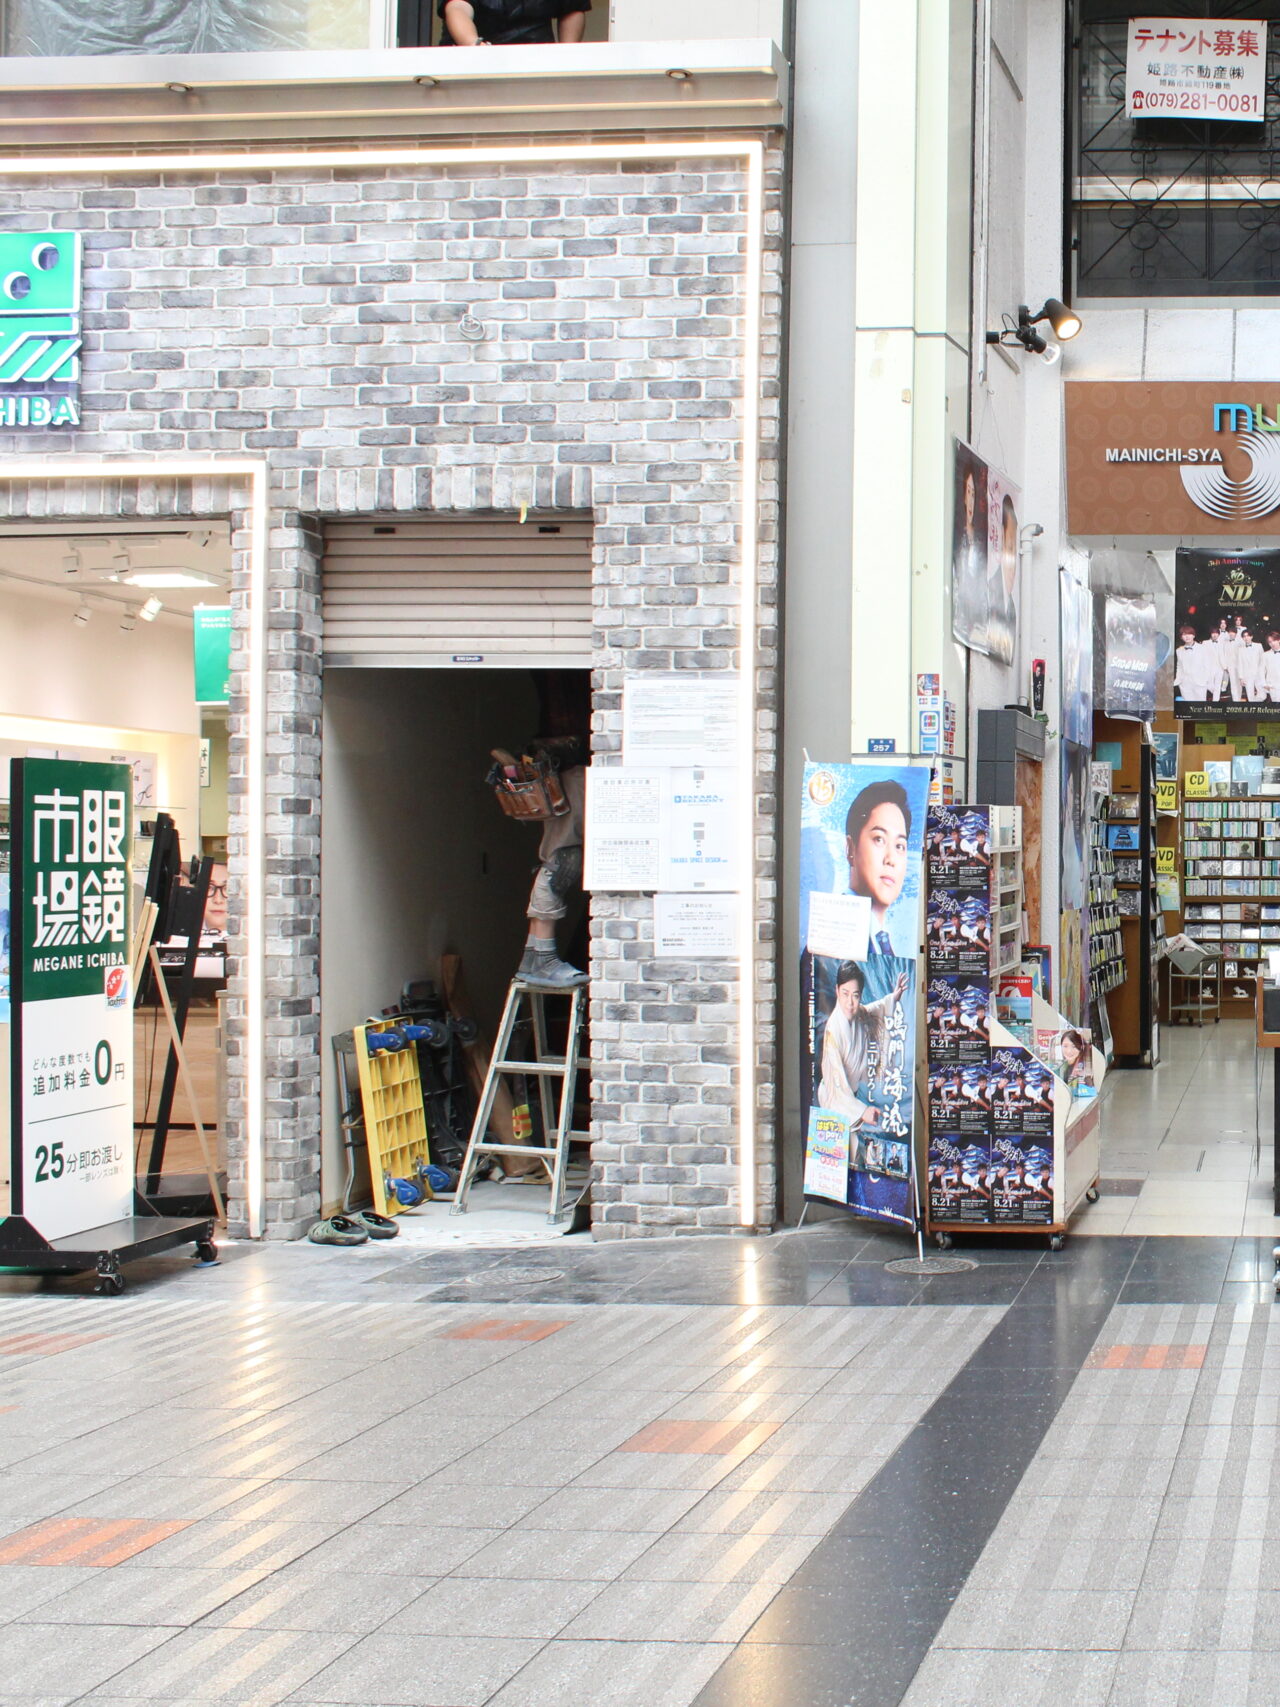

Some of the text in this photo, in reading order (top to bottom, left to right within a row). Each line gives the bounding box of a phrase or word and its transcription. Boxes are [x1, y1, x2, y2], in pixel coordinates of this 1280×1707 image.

[1134, 28, 1259, 57] テナント募集
[1145, 91, 1258, 112] (079)281-0081
[1104, 447, 1223, 463] MAINICHI-SYA
[1189, 774, 1205, 785] CD
[1157, 850, 1174, 861] VD
[930, 865, 949, 874] 8.21
[930, 950, 949, 959] 8.21
[33, 952, 125, 973] MEGANE ICHIBA
[930, 1039, 949, 1048] 8.21
[33, 1052, 91, 1071] どんな度数でも
[867, 1041, 879, 1103] 三山ひろし
[881, 1001, 908, 1137] 鳴門海流
[33, 1068, 91, 1096] 追加料金
[931, 1109, 950, 1118] 8.21
[993, 1110, 1012, 1120] 8.21
[931, 1198, 950, 1207] 8.21
[993, 1199, 1012, 1208] 8.21
